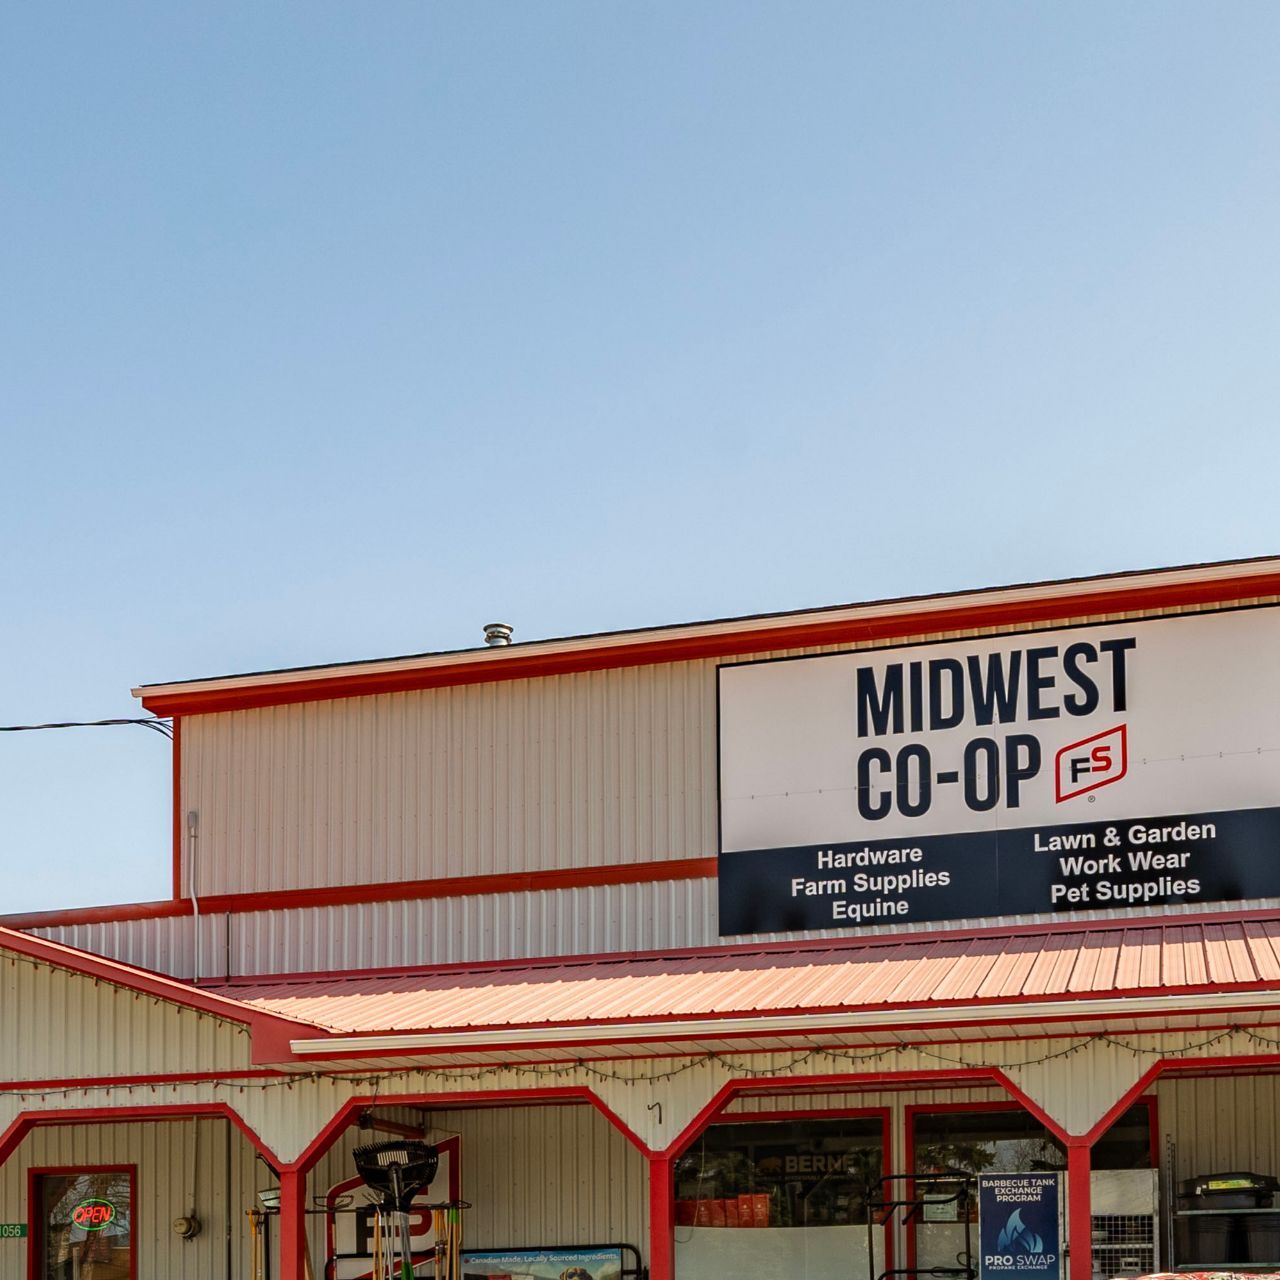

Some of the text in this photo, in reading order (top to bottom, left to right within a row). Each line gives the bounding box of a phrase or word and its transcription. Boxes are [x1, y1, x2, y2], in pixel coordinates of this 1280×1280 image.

[856, 637, 1137, 738] MIDWEST
[857, 733, 1042, 821] CO-OP
[1071, 745, 1113, 783] FS
[1033, 820, 1217, 853] Lawn & Garden
[817, 846, 923, 870] Hardware
[1059, 849, 1191, 877] Work Wear
[791, 868, 951, 897] Farm Supplies
[1050, 875, 1201, 904] Pet Supplies
[831, 899, 909, 921] Equine
[982, 1178, 1055, 1188] BARBECUE TANK
[994, 1187, 1042, 1195] EXCHANGE
[996, 1194, 1041, 1202] PROGRAM
[73, 1206, 111, 1223] OPEN
[985, 1254, 1056, 1266] PRO SWAP
